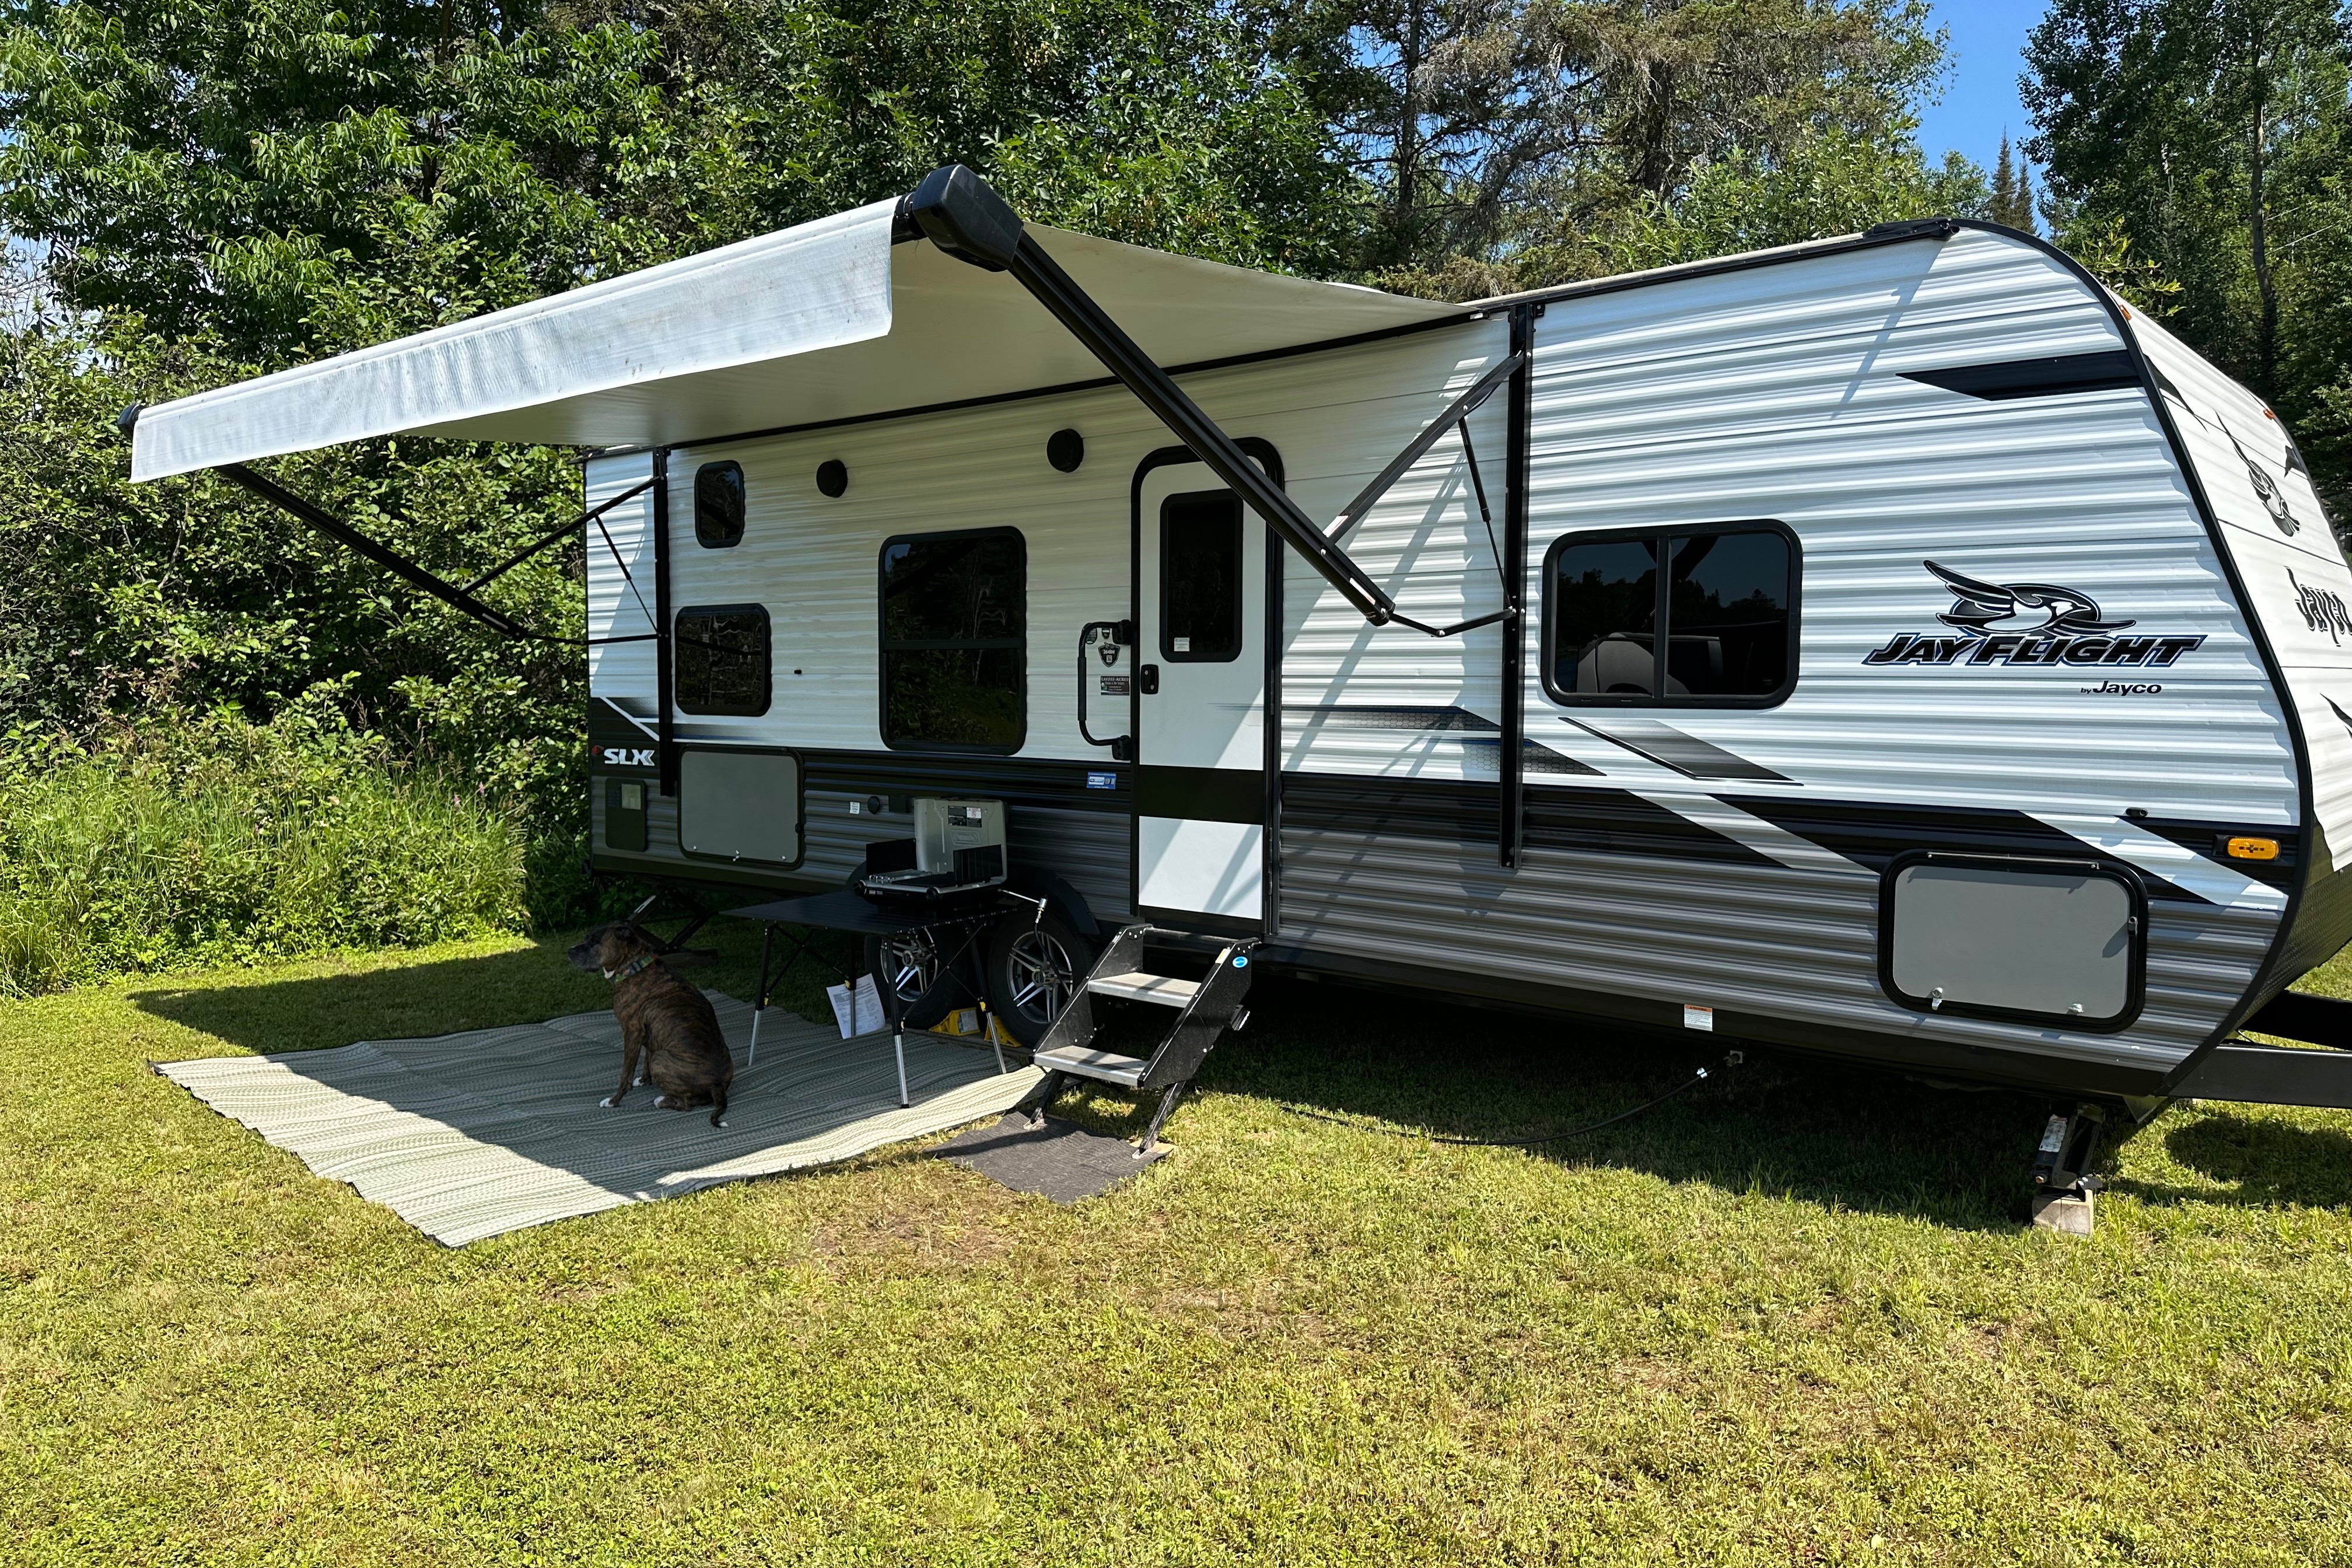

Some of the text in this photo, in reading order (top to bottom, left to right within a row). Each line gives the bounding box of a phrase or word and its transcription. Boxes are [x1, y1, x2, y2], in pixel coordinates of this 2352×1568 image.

[2286, 566, 2352, 647] Jayco
[1861, 632, 2208, 667] JAY FLIGHT
[2092, 680, 2162, 696] Jayco
[604, 748, 654, 766] SLX
